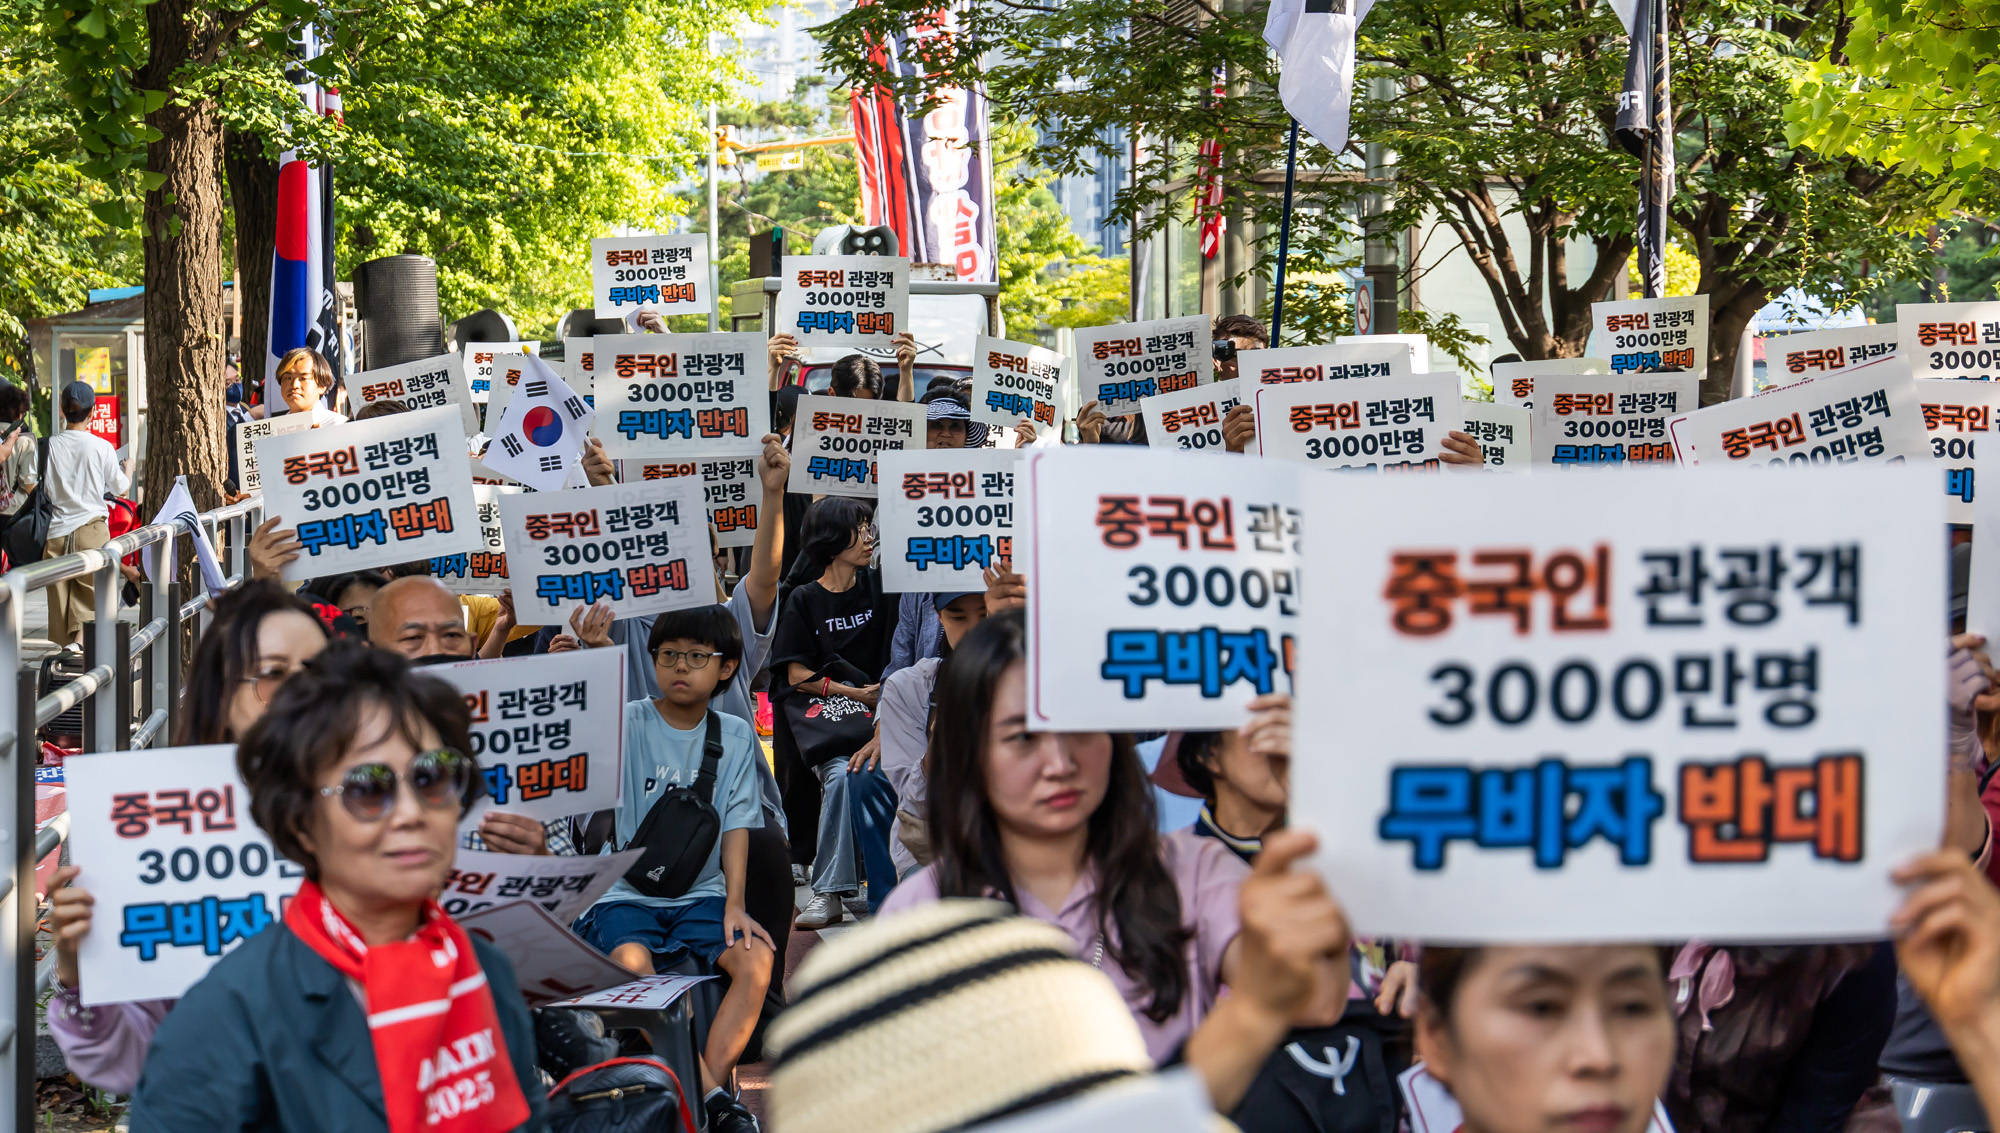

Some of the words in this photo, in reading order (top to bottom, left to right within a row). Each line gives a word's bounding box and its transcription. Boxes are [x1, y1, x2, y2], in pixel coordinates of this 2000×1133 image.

[606, 248, 648, 267] 중국인
[651, 247, 693, 264] 관광객
[615, 265, 686, 282] 3000만명
[797, 270, 844, 288] 중국인
[848, 271, 894, 288] 관광객
[609, 284, 660, 306] 무비자
[661, 282, 696, 303] 반대
[806, 291, 886, 308] 3000만명
[797, 311, 855, 333] 무비자
[857, 312, 894, 334] 반대
[1606, 312, 1650, 332] 중국인
[1653, 310, 1695, 328] 관광객
[1917, 321, 1977, 346] 중국인
[1092, 337, 1143, 360] 중국인
[1145, 331, 1194, 353] 관광객
[1615, 329, 1688, 349] 3000만명
[614, 352, 678, 378] 중국인
[683, 352, 745, 376] 관광객
[987, 351, 1028, 374] 중국인
[1030, 360, 1060, 384] 관광객
[1104, 352, 1187, 377] 3000만명
[1611, 351, 1661, 374] 무비자
[1786, 346, 1845, 374] 중국인
[361, 378, 405, 403] 중국인
[406, 369, 451, 393] 관광객
[627, 380, 735, 403] 3000만명
[994, 373, 1053, 400] 3000만명
[1098, 377, 1157, 405] 무비자
[1158, 371, 1198, 394] 반대
[985, 390, 1033, 418] 무비자
[1034, 400, 1056, 427] 반대
[1162, 401, 1219, 433] 중국인
[1289, 401, 1361, 433] 중국인
[1366, 396, 1435, 427] 관광객
[1553, 392, 1614, 416] 중국인
[1618, 392, 1677, 413] 관광객
[1921, 403, 1989, 432] 중국인
[243, 422, 271, 439] 중국인
[617, 408, 695, 440] 무비자
[697, 407, 749, 438] 반대
[812, 411, 863, 434] 중국인
[866, 417, 913, 437] 관광객
[1463, 421, 1514, 445] 관광객
[1564, 418, 1665, 439] 3000만명
[1721, 412, 1806, 460] 중국인
[1808, 388, 1891, 437] 관광객
[1177, 429, 1226, 451] 300
[1305, 428, 1425, 459] 3000만명
[245, 457, 258, 470] 자
[283, 445, 360, 486] 중국인
[363, 432, 440, 472] 관광객
[701, 459, 754, 481] 관광객
[807, 456, 869, 484] 무비자
[302, 466, 432, 512] 3000만명
[902, 470, 976, 500] 중국인
[297, 507, 388, 556] 무비자
[389, 496, 454, 540] 반대
[525, 508, 601, 541] 중국인
[605, 500, 679, 533] 관광객
[714, 504, 757, 533] 반대
[1096, 494, 1237, 551] 중국인
[543, 531, 669, 566] 3000만명
[905, 534, 995, 571] 무비자
[536, 567, 625, 606] 무비자
[626, 558, 689, 597] 반대
[1381, 541, 1613, 637] 중국인
[1635, 541, 1862, 629] 관광객
[816, 609, 873, 635] TELIER
[1101, 626, 1277, 700] 무비자
[497, 679, 588, 721] 관광객
[1427, 645, 1820, 731] 3000만명
[516, 751, 589, 802] 반대
[655, 764, 701, 783] WAE
[111, 784, 237, 838] 중국인
[1377, 753, 1664, 872] 무비자
[1678, 752, 1866, 863] 반대
[121, 893, 273, 961] 무비자
